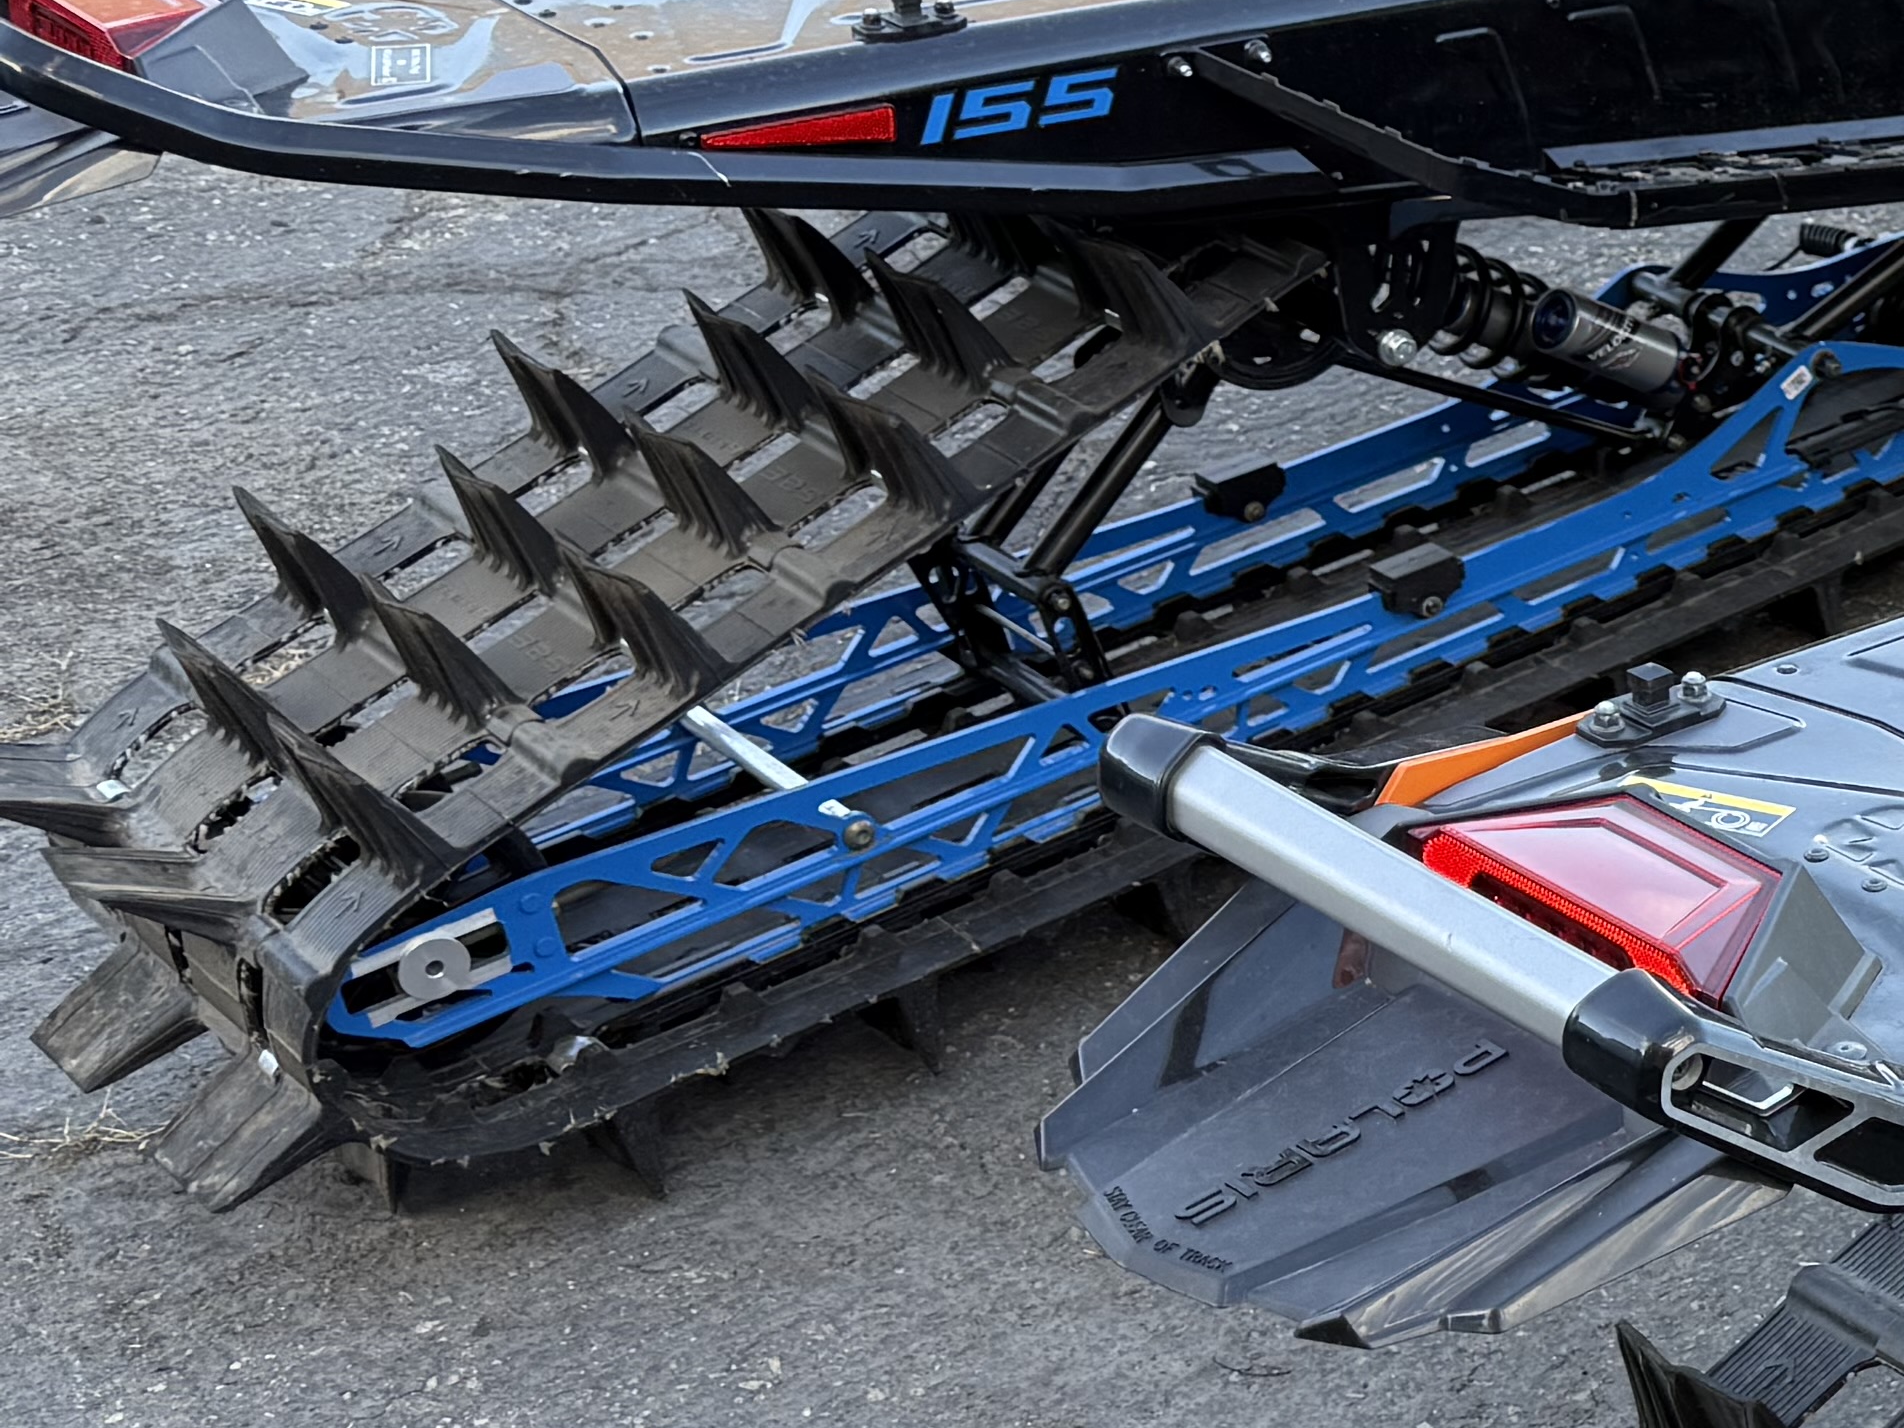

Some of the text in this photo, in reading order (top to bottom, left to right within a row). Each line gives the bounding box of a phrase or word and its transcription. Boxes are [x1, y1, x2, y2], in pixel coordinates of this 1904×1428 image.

[919, 67, 1119, 147] 155
[1174, 1038, 1510, 1229] POLARIS
[1103, 1185, 1233, 1274] STAY CLEAR OF TRACK
